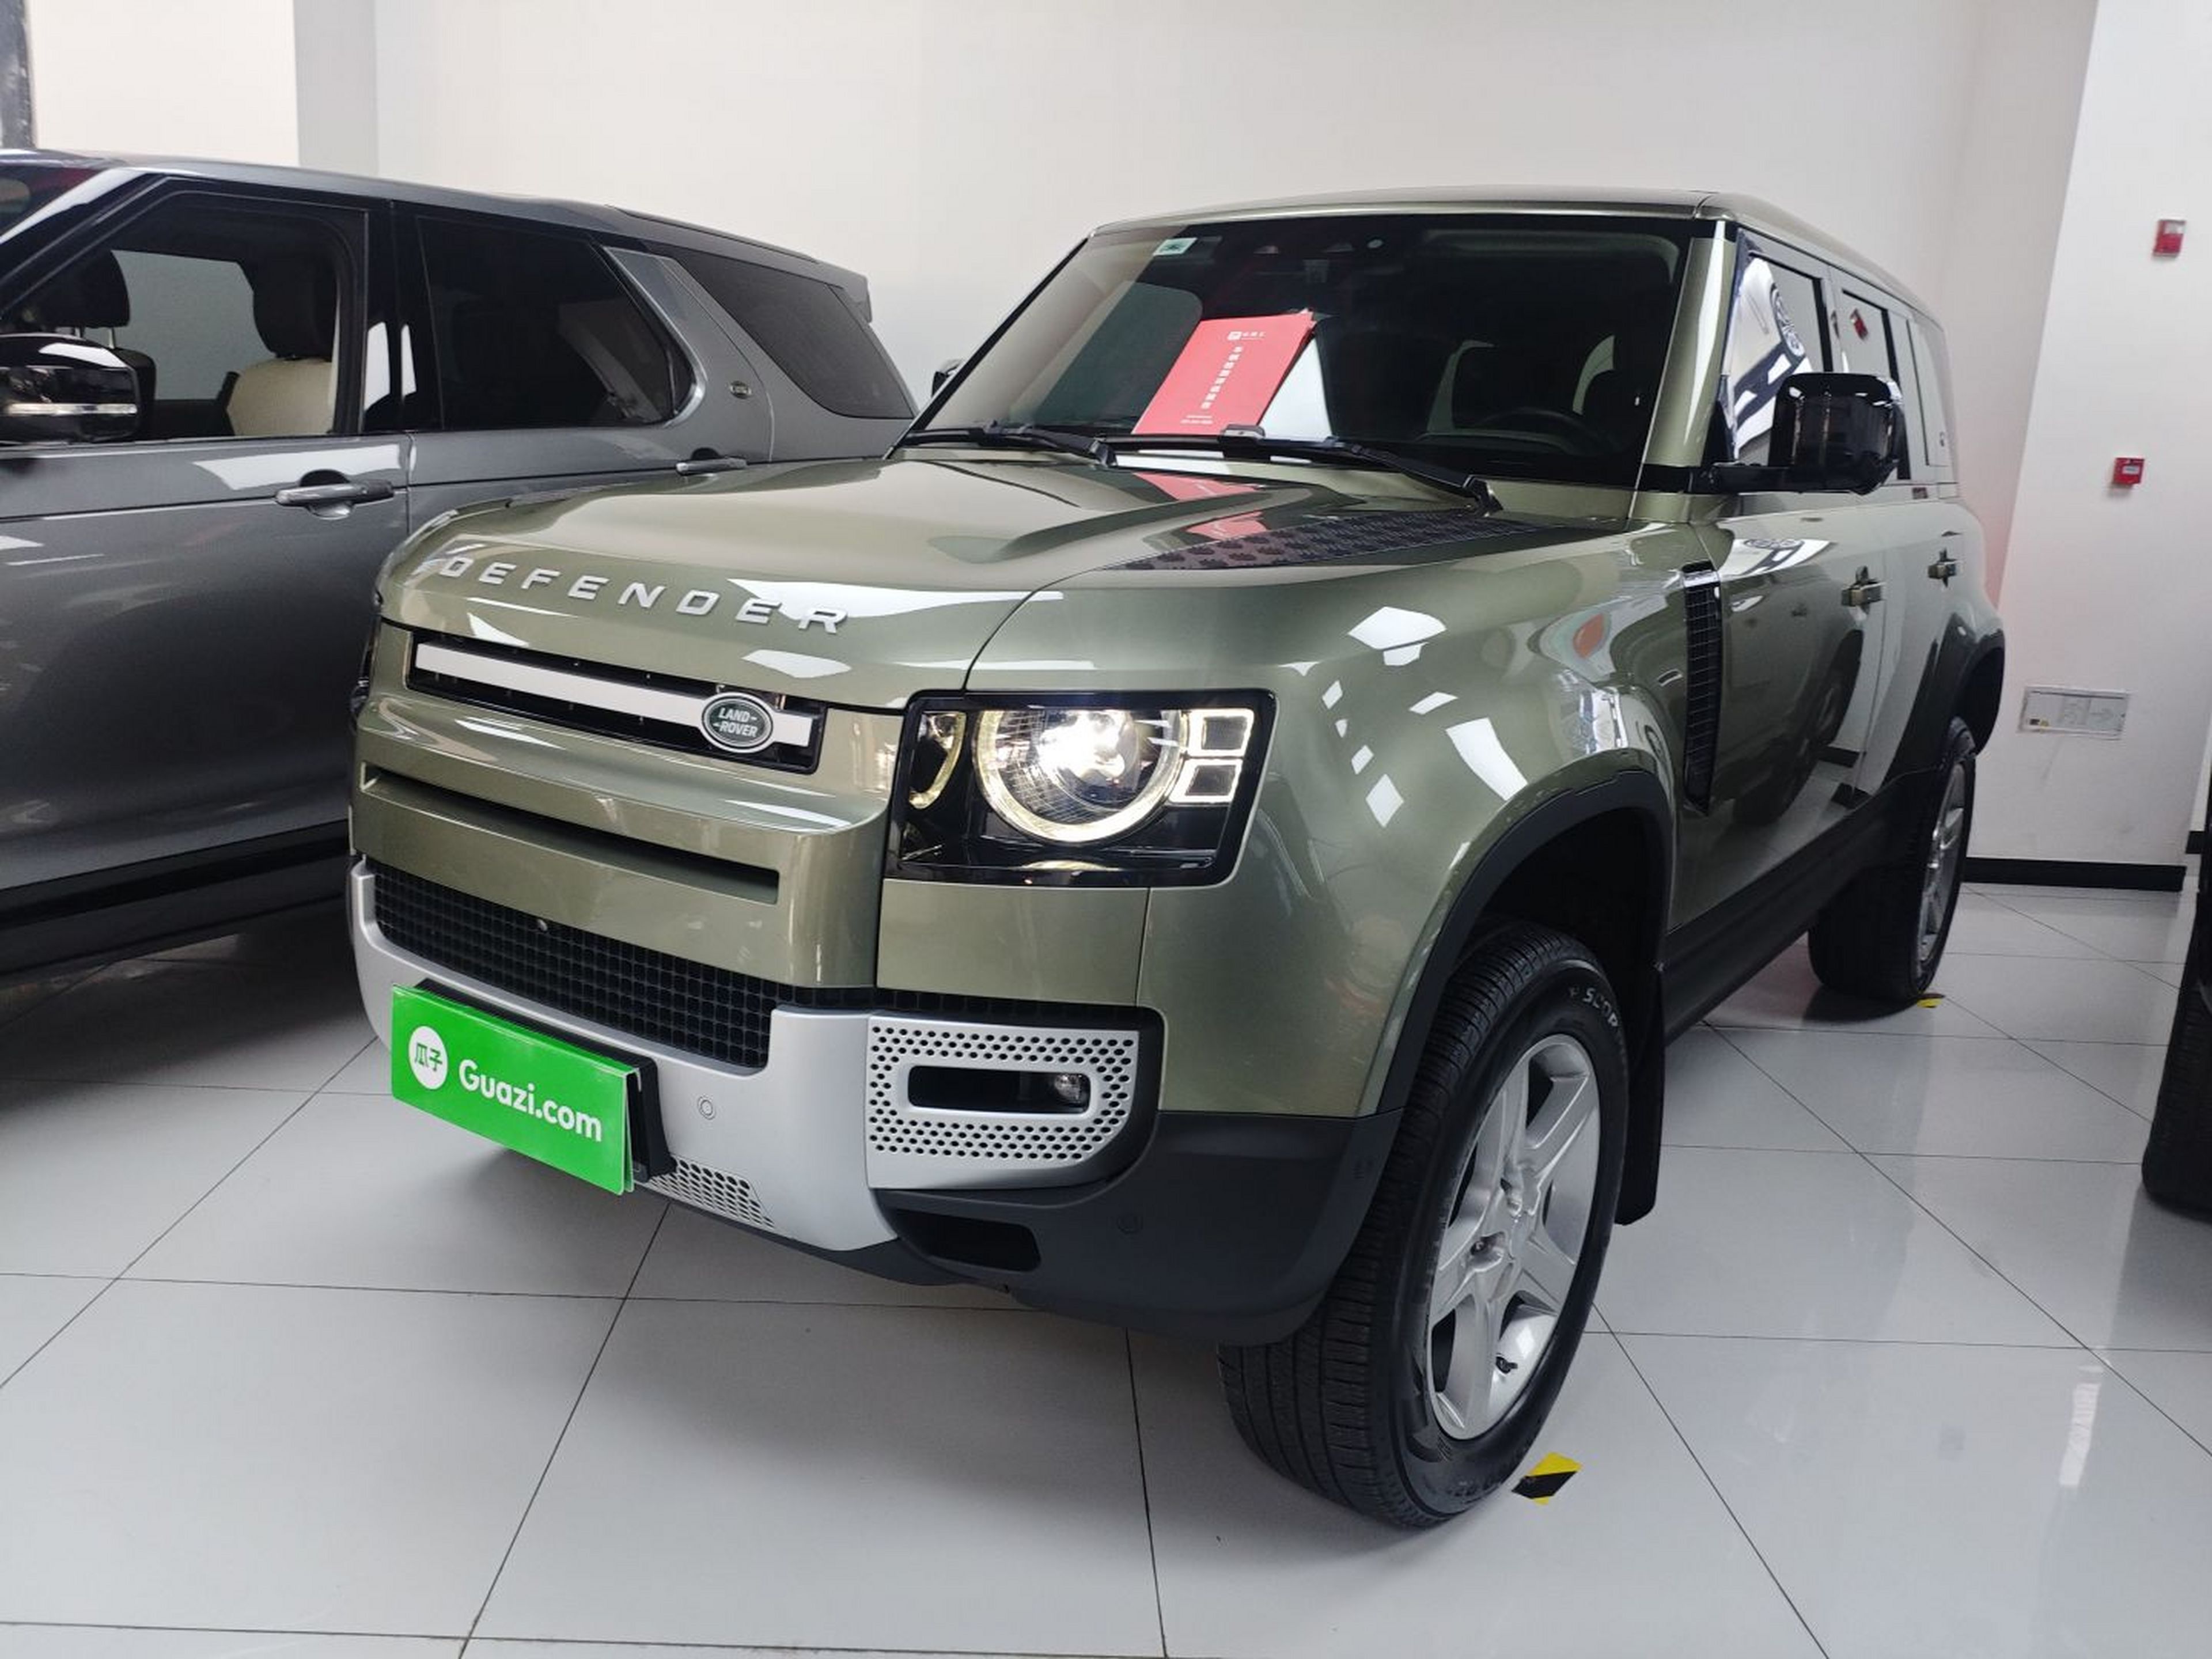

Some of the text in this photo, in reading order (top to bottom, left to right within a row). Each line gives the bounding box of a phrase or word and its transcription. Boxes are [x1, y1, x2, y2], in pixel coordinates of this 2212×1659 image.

[439, 556, 847, 634] DEFENDER
[414, 1043, 443, 1072] 瓜子
[459, 1059, 602, 1142] Guazi.com
